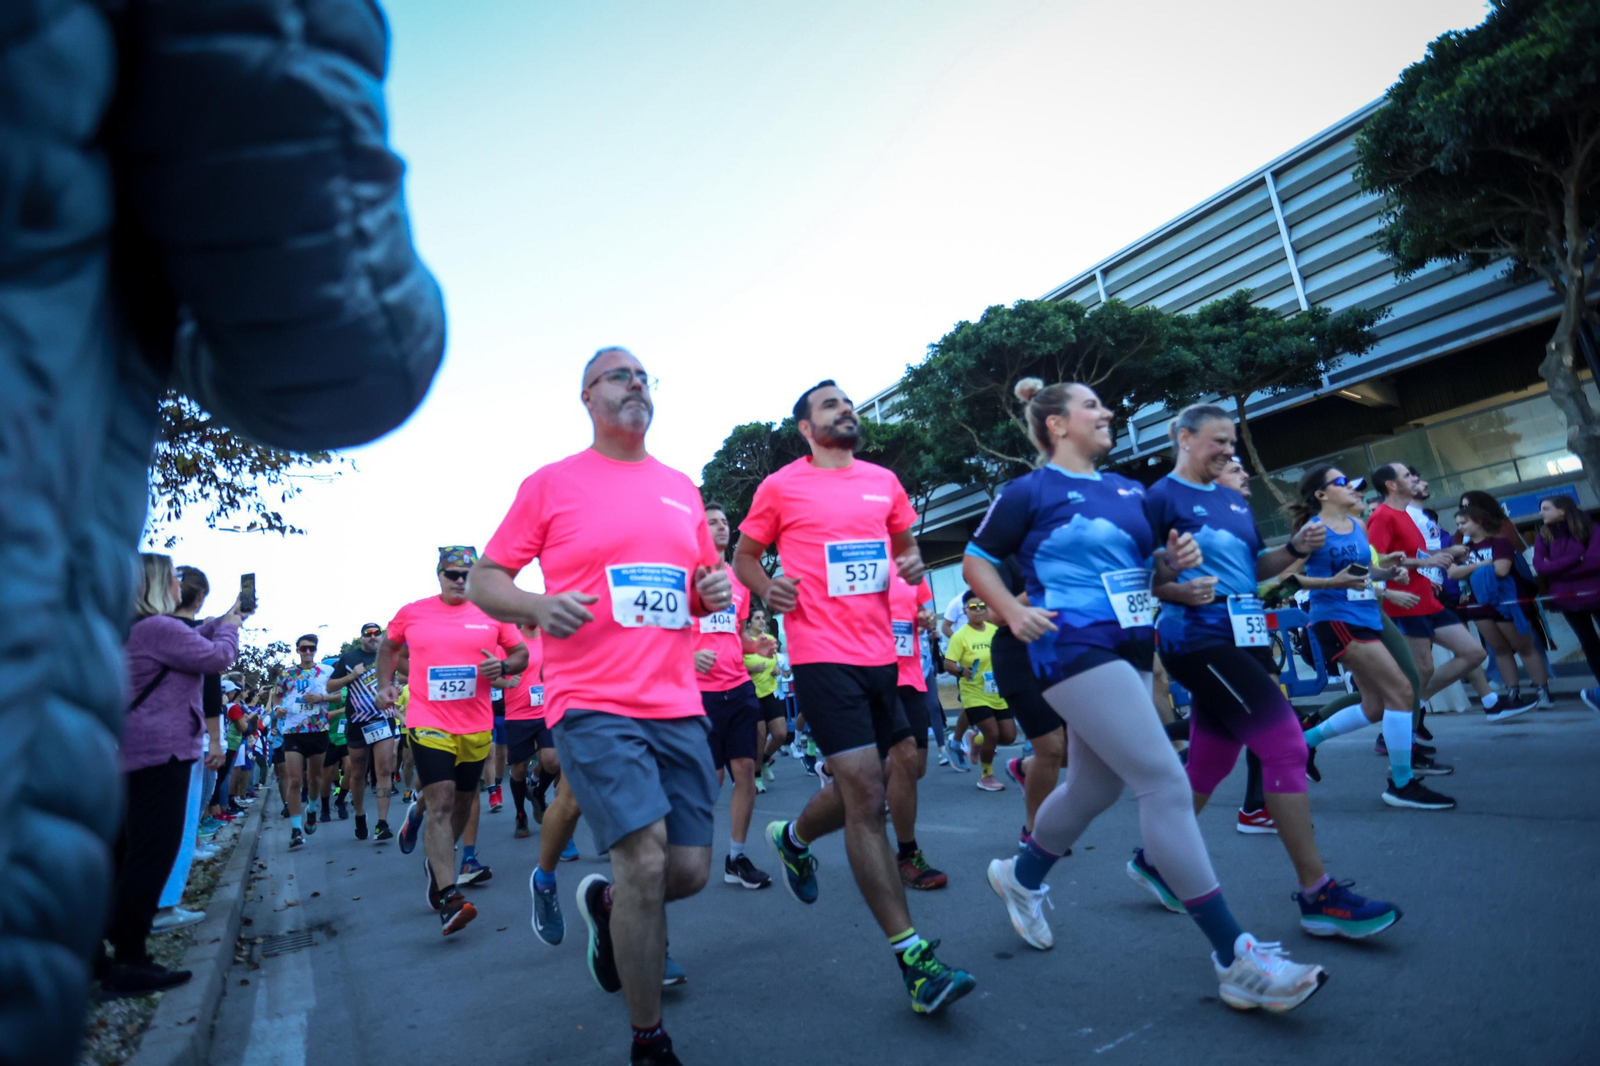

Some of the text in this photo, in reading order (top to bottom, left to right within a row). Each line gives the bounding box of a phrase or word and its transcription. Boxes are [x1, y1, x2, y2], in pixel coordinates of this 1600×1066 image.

[846, 563, 877, 582] 537
[634, 590, 678, 613] 420
[710, 614, 731, 625] 404
[439, 680, 466, 693] 452
[370, 728, 385, 739] 117
